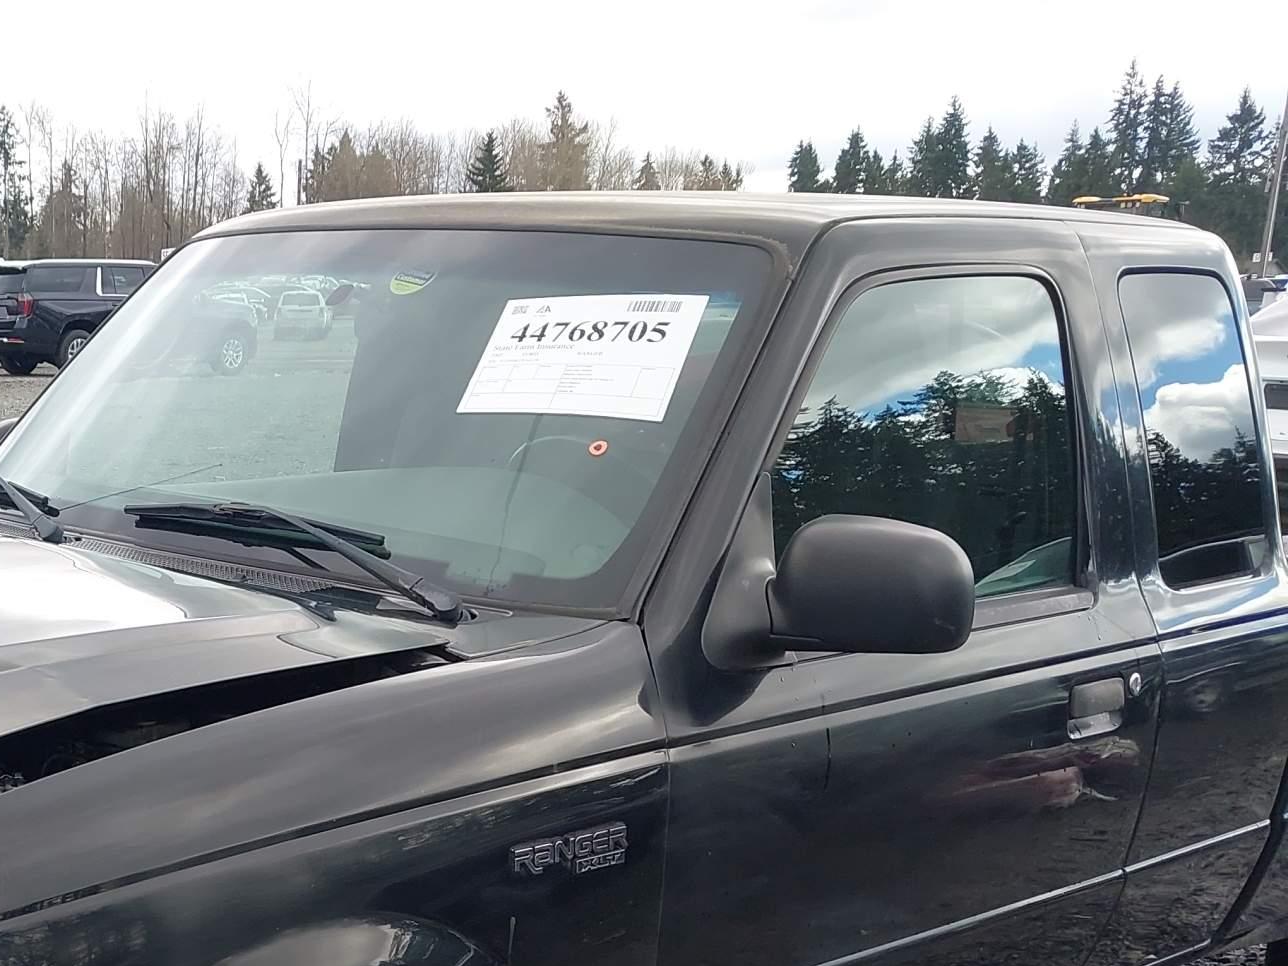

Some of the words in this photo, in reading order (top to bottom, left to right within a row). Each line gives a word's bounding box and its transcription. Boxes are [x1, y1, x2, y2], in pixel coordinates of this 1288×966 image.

[510, 320, 672, 343] 44768705
[513, 825, 629, 874] RANGER
[578, 850, 625, 873] XLT
